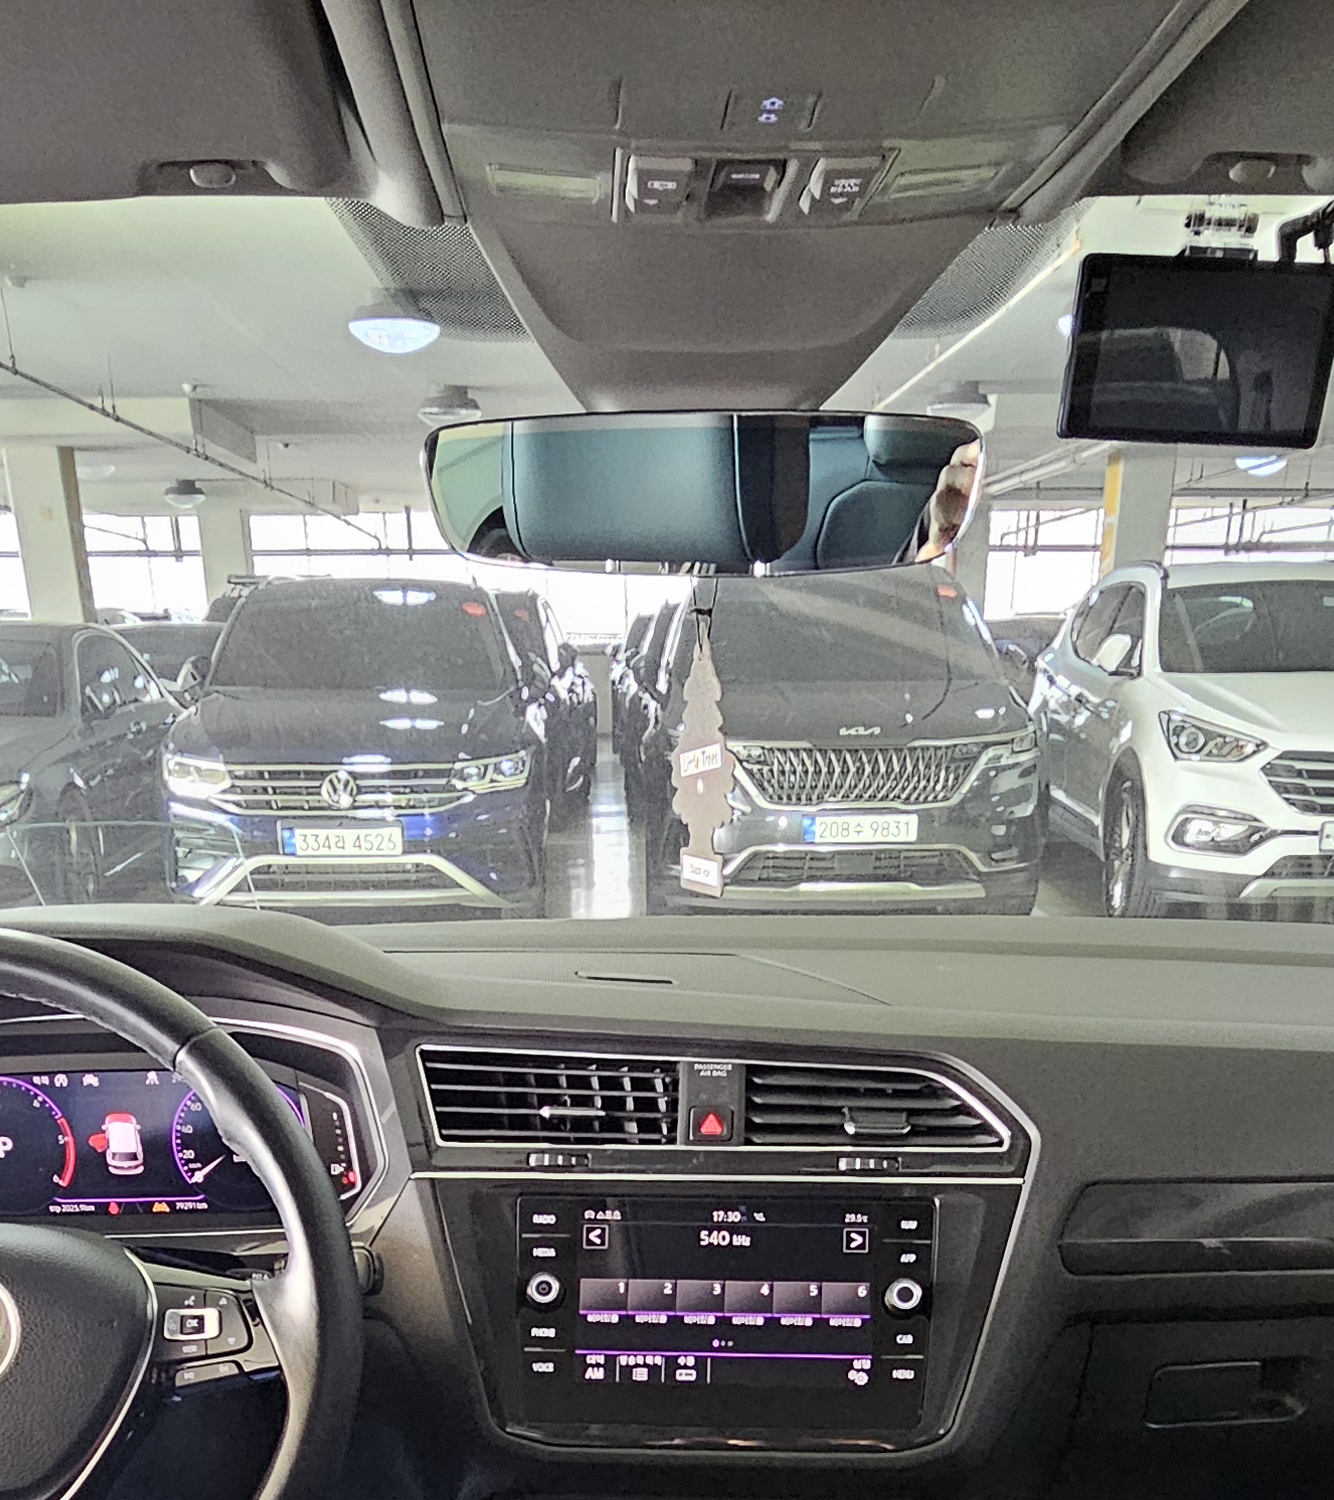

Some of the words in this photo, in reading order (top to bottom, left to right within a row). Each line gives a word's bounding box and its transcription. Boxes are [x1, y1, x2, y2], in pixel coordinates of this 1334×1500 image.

[818, 820, 865, 839] 208수
[869, 820, 911, 838] 9831
[298, 832, 346, 852] 334라
[352, 832, 398, 852] 4526
[183, 1149, 195, 1159] 20
[712, 1211, 741, 1223] 17:30
[699, 1230, 731, 1247] 540
[732, 1234, 752, 1247] kHz
[618, 1281, 626, 1294] 1
[663, 1282, 673, 1295] 2
[712, 1283, 722, 1296] 3
[759, 1283, 770, 1296] 4
[808, 1285, 819, 1297] 5
[857, 1286, 867, 1298] 6
[584, 1367, 605, 1380] AM
